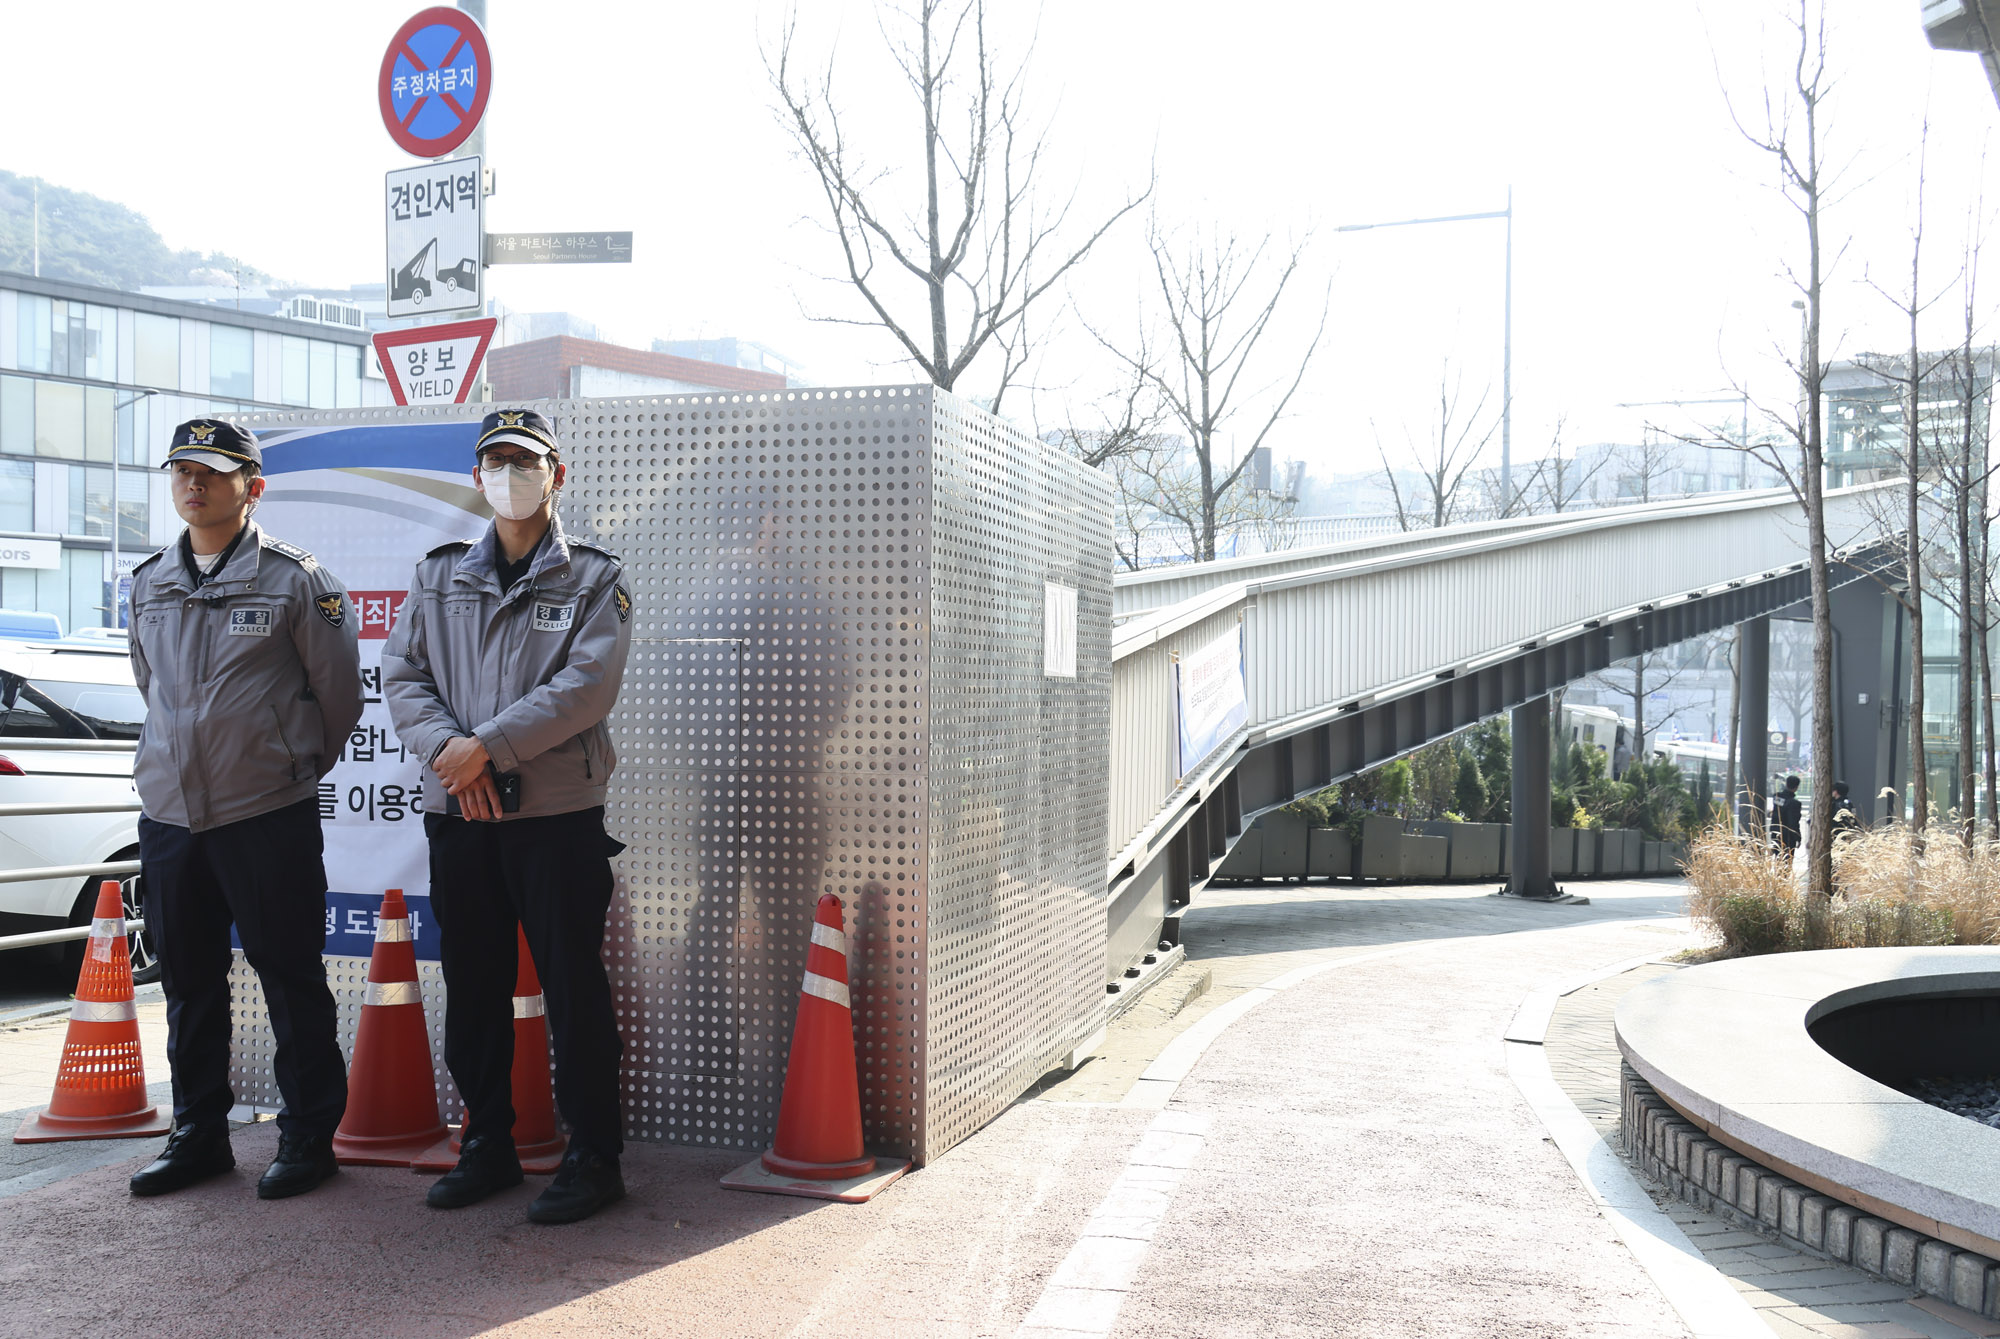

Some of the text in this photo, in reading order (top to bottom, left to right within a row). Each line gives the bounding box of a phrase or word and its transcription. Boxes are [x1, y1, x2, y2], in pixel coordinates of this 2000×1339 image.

[393, 64, 474, 99] 주정차금지
[391, 171, 476, 221] 견인지역
[496, 235, 597, 250] 서울 파트너스 하우스
[409, 378, 453, 399] YIELD
[0, 549, 31, 561] ors
[537, 621, 569, 629] POLICE
